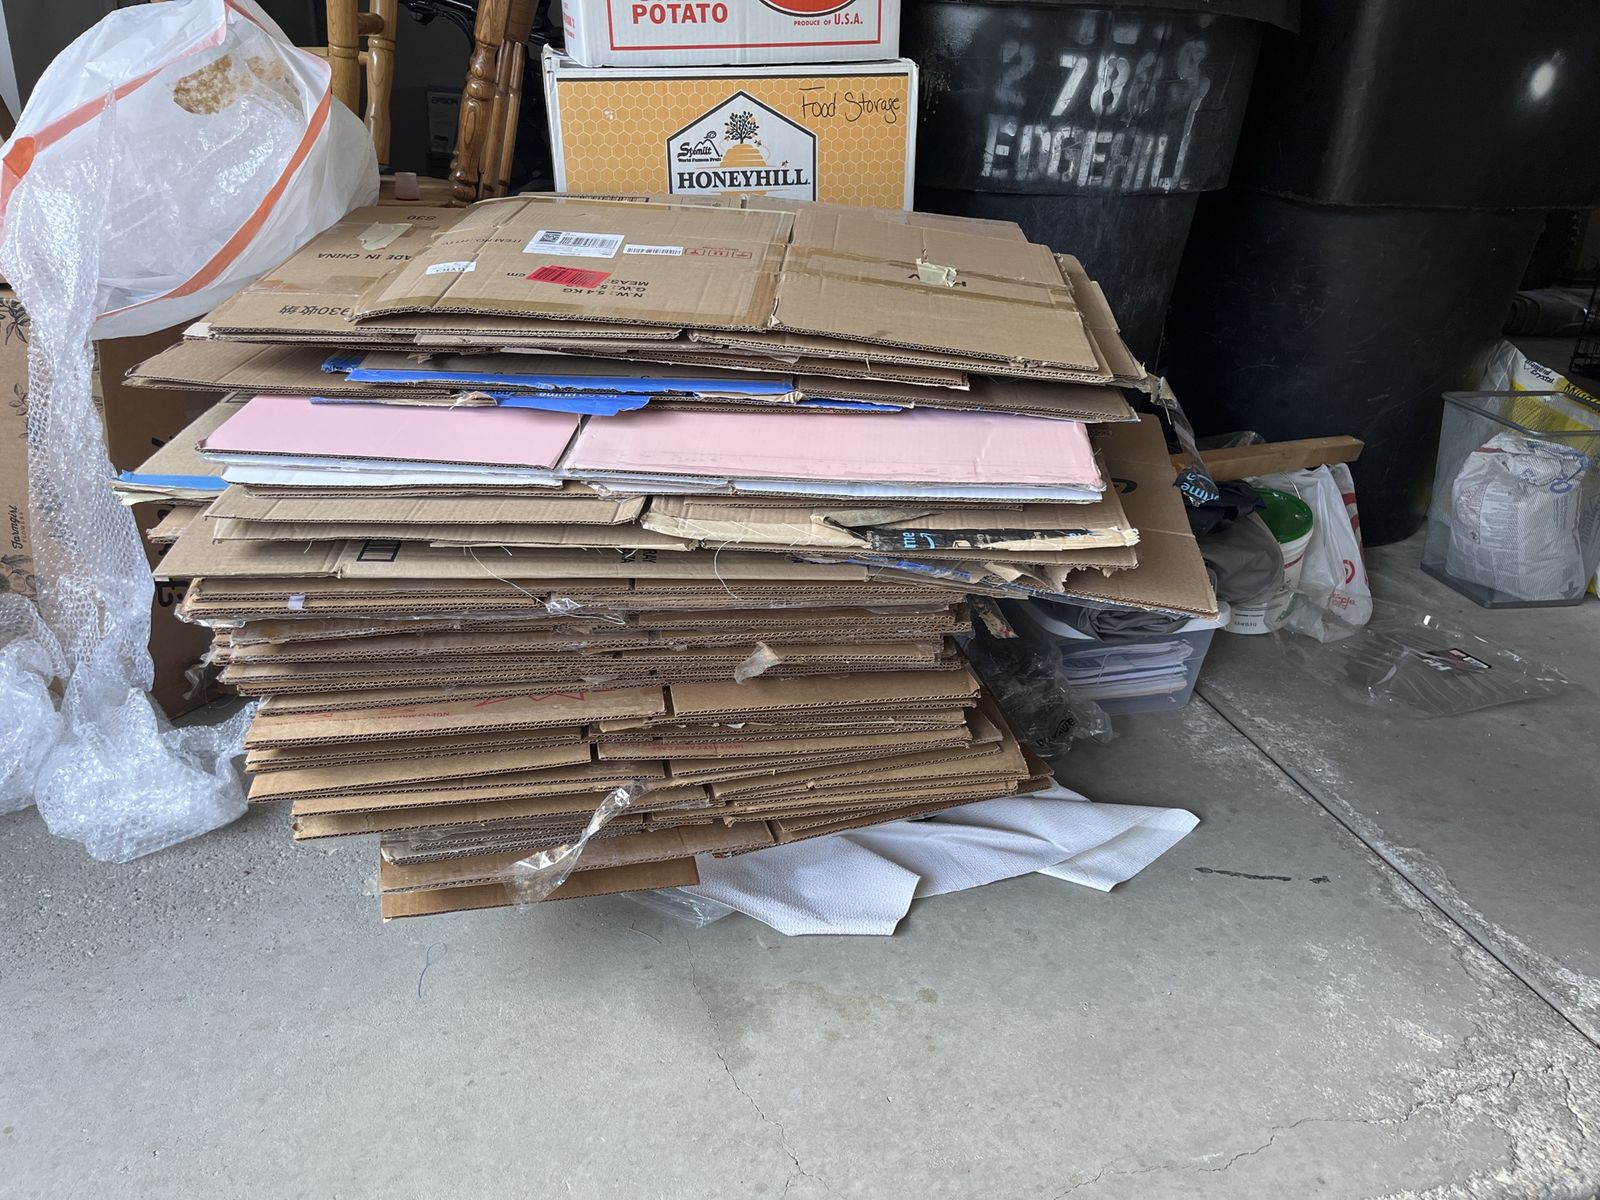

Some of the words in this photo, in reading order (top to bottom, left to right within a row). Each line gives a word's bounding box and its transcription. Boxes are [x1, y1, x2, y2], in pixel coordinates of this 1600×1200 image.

[632, 3, 728, 24] POTATO
[834, 13, 864, 25] U.S.A.
[799, 86, 837, 119] Food
[844, 91, 900, 124] Storage
[677, 169, 809, 189] HONEYHILL
[317, 252, 360, 261] CHINA
[365, 253, 382, 261] IN
[387, 253, 413, 261] ADE
[11, 504, 24, 550] Farmgirl
